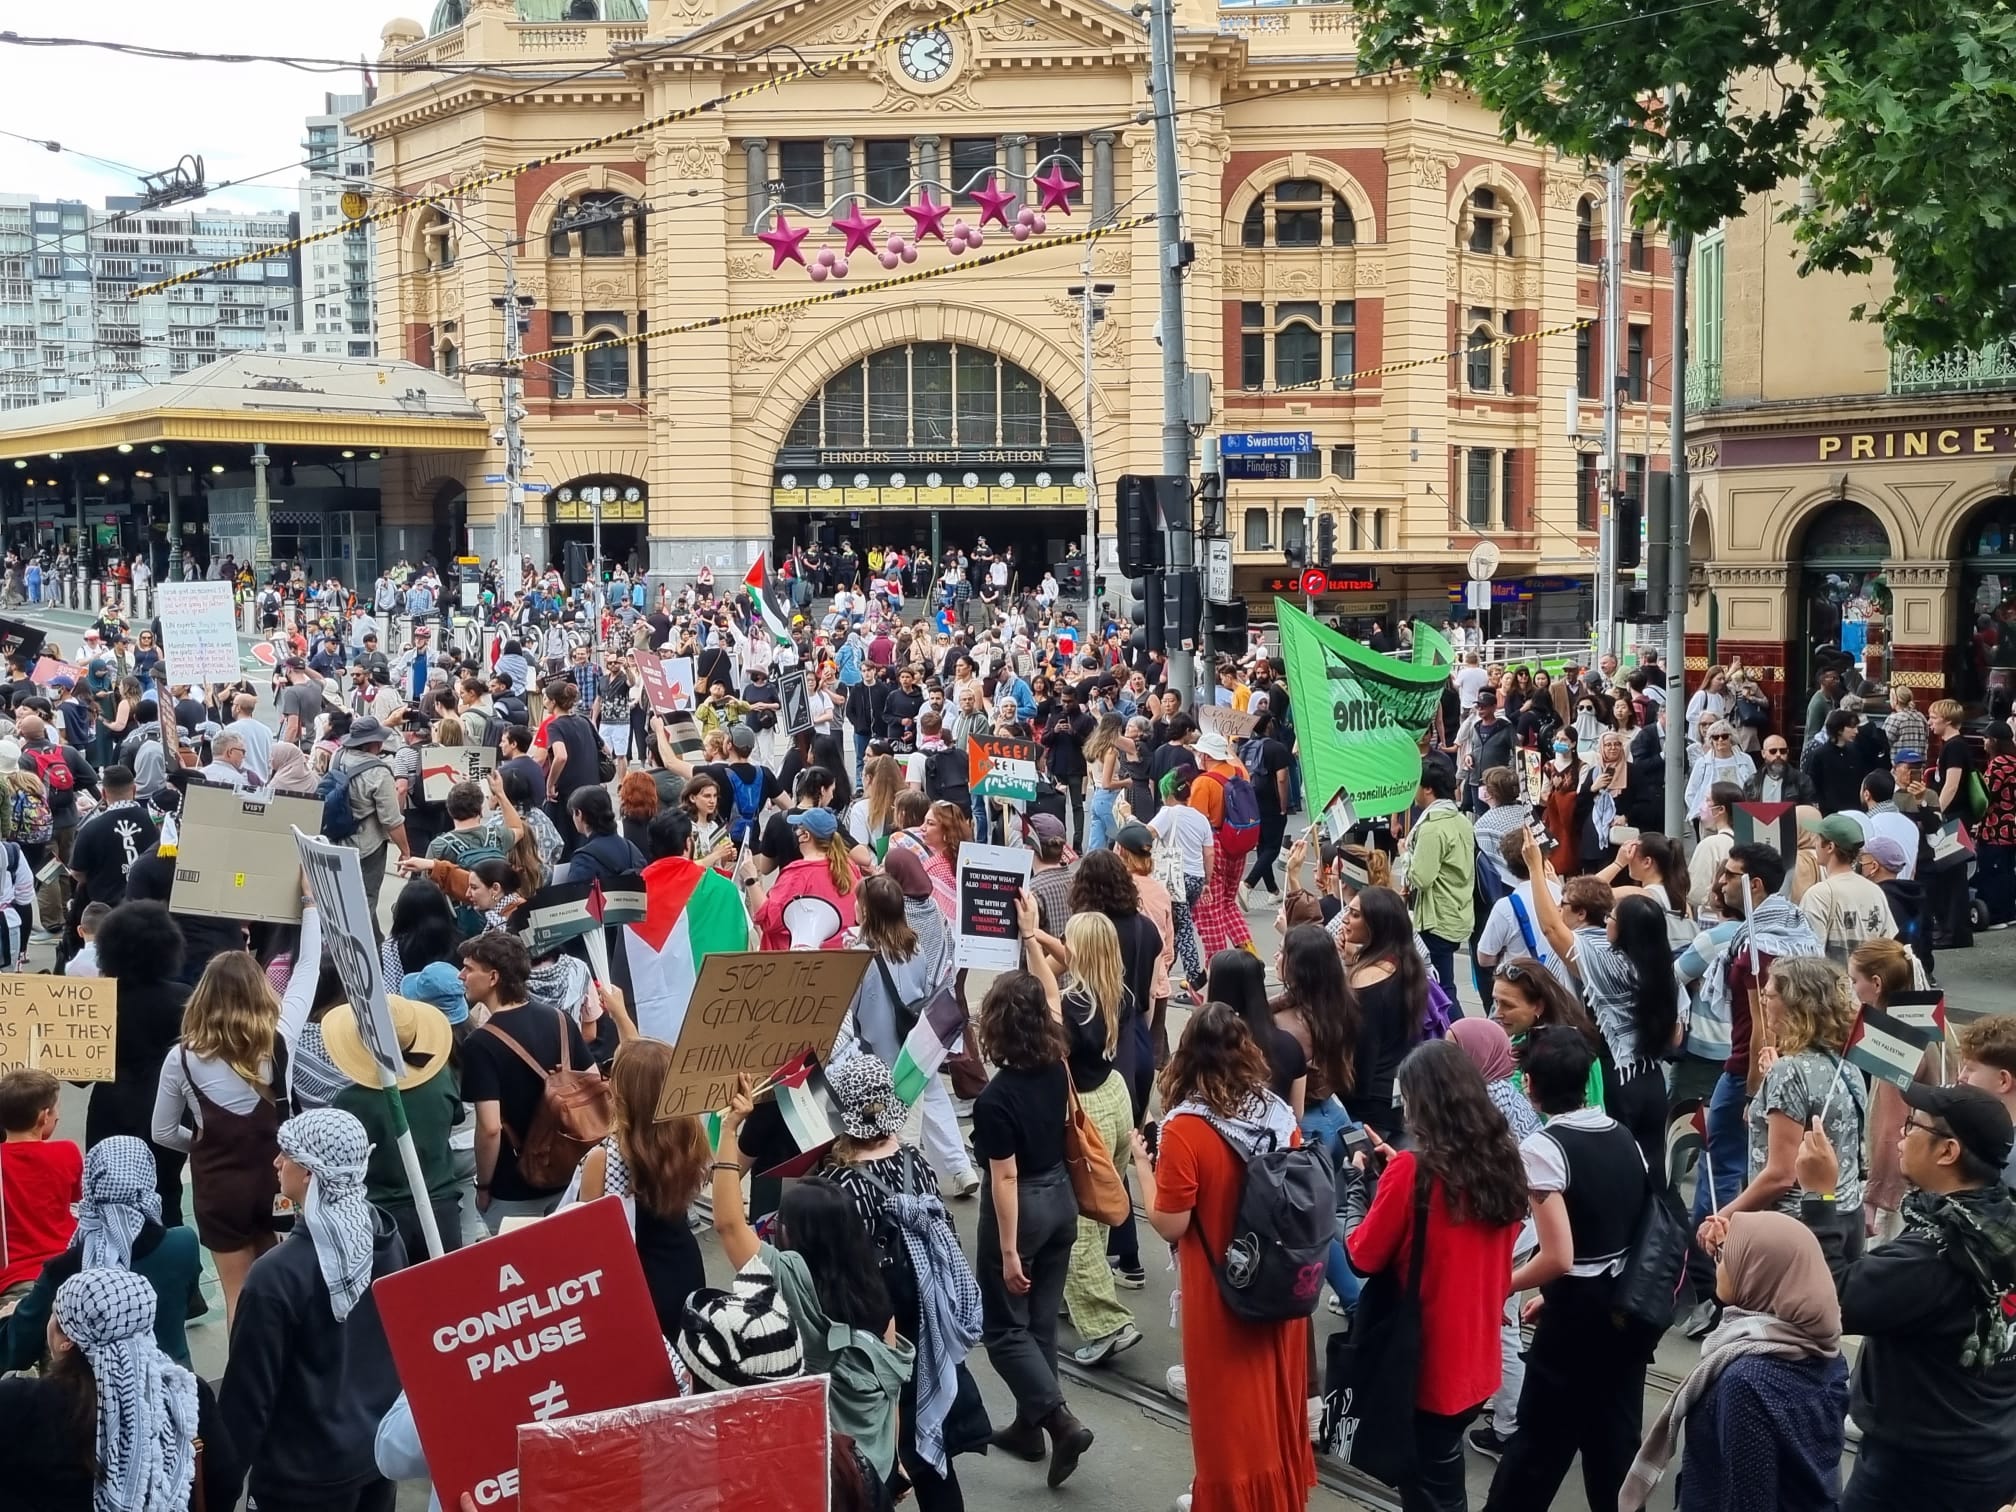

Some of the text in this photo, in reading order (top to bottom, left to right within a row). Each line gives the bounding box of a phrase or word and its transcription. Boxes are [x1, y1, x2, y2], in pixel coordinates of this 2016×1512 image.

[1246, 433, 1309, 448] Swanston St
[1819, 427, 2016, 461] PRINCE'
[821, 450, 1043, 464] FLINDERS STREET STATION
[1246, 459, 1289, 473] Flinders St
[983, 741, 1029, 761] FREE!
[984, 775, 1034, 792] PALESTINE
[719, 961, 824, 992] STOP THE
[47, 984, 93, 1001] WHO
[25, 1002, 39, 1016] A
[58, 1003, 98, 1019] LIFE
[702, 995, 839, 1029] GENOCIDE
[37, 1022, 55, 1037] IF
[66, 1024, 112, 1039] THEY
[40, 1043, 76, 1058] ALL
[85, 1045, 108, 1060] OF
[679, 1041, 757, 1075] ETHNIC
[1881, 1043, 1906, 1058] PALESTINE
[664, 1086, 697, 1115] OF
[499, 1263, 525, 1292] A
[432, 1268, 604, 1353] CONFLICT
[466, 1316, 587, 1382] PAUSE
